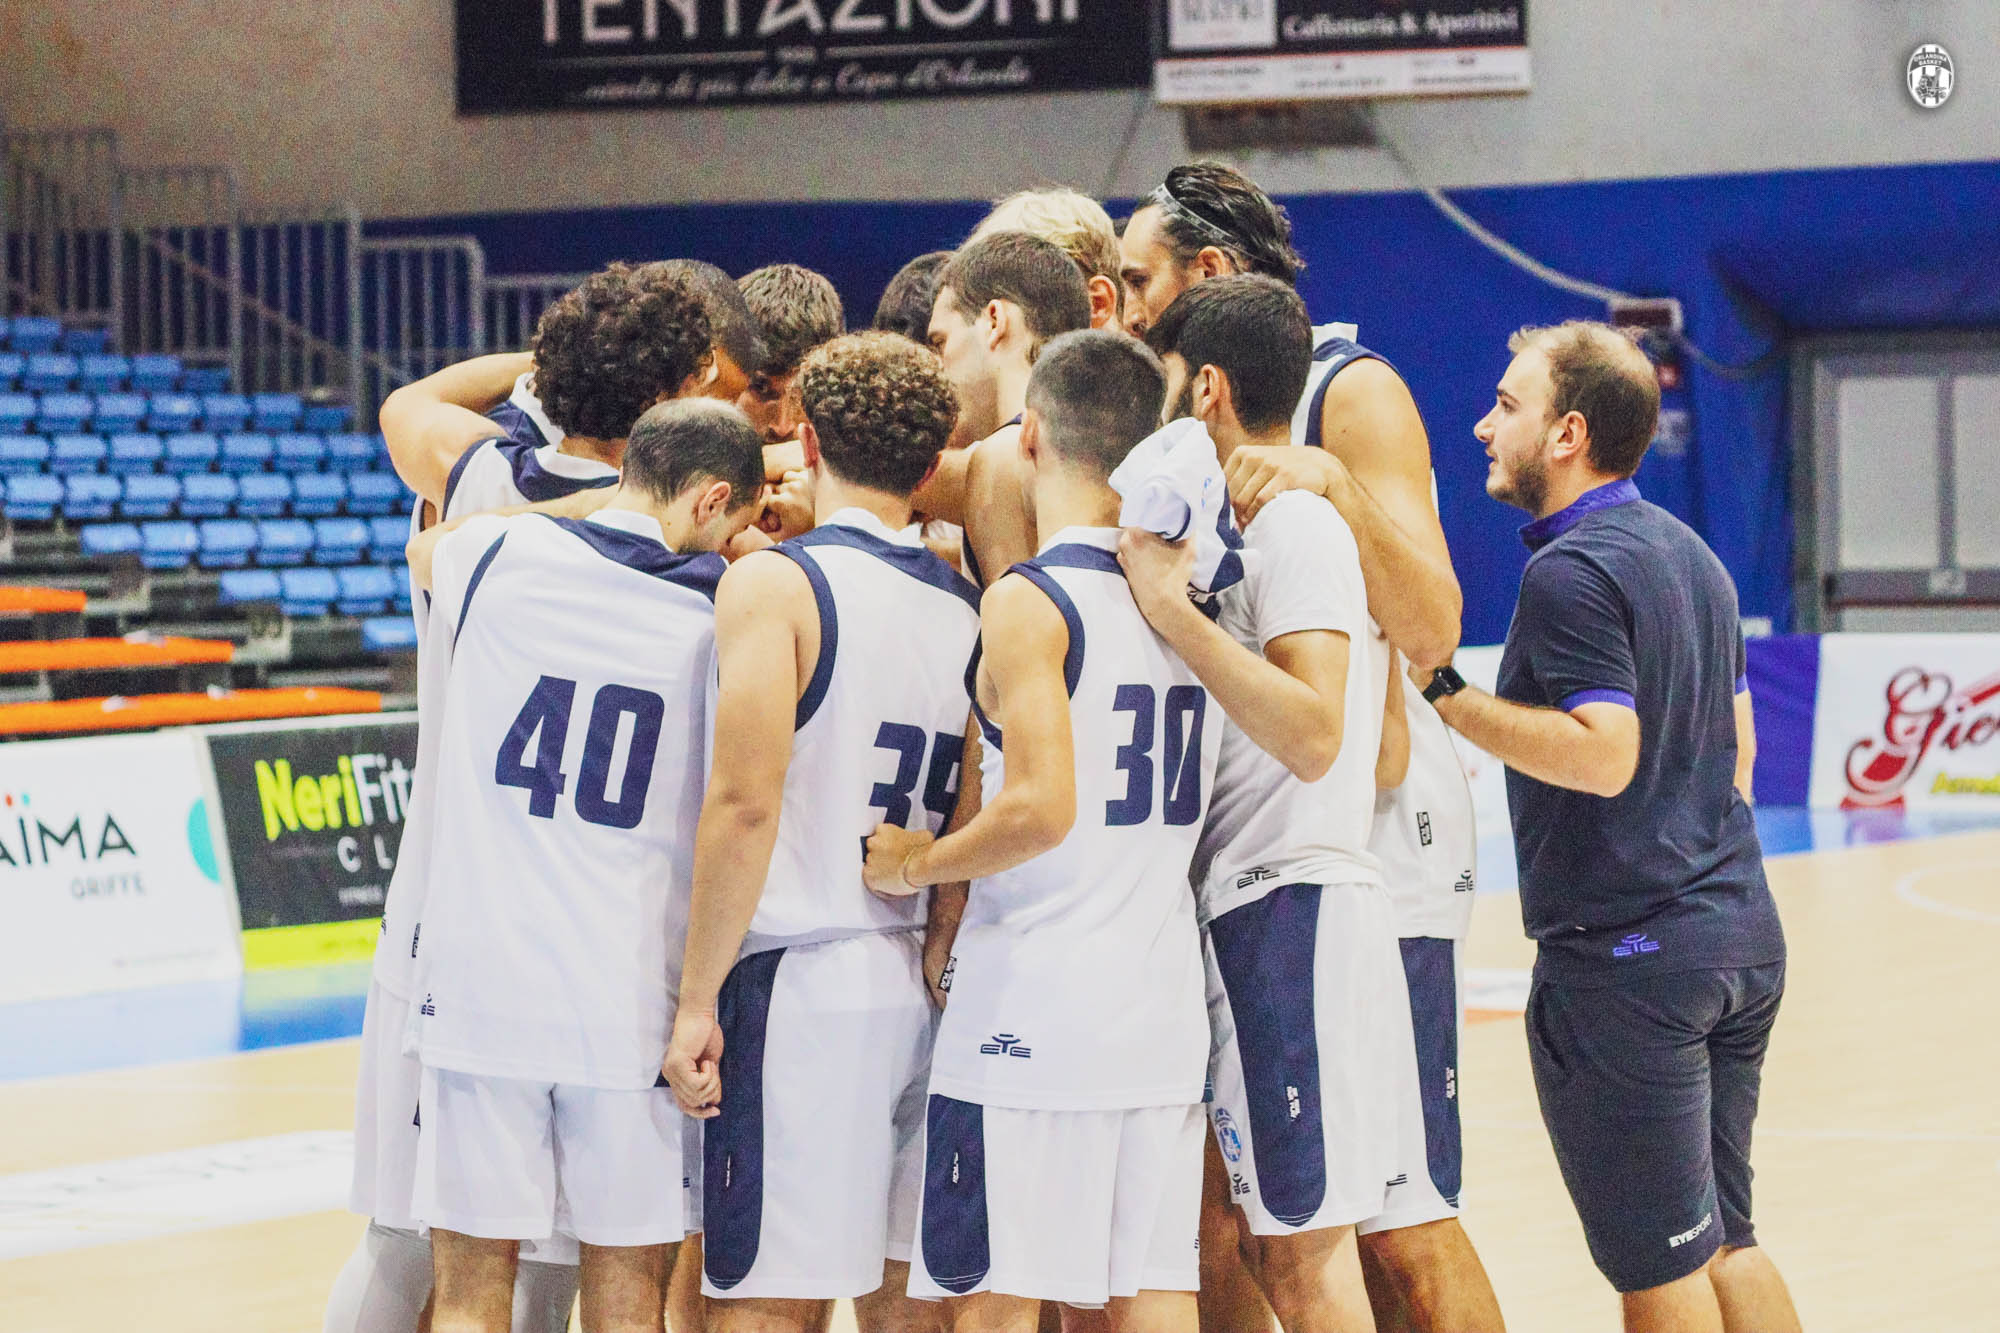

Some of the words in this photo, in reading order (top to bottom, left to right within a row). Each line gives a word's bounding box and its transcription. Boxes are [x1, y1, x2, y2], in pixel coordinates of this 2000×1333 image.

[254, 753, 415, 842] NeriFit
[495, 675, 665, 830] 40
[1105, 684, 1207, 826] 30
[1845, 666, 2000, 794] Gio
